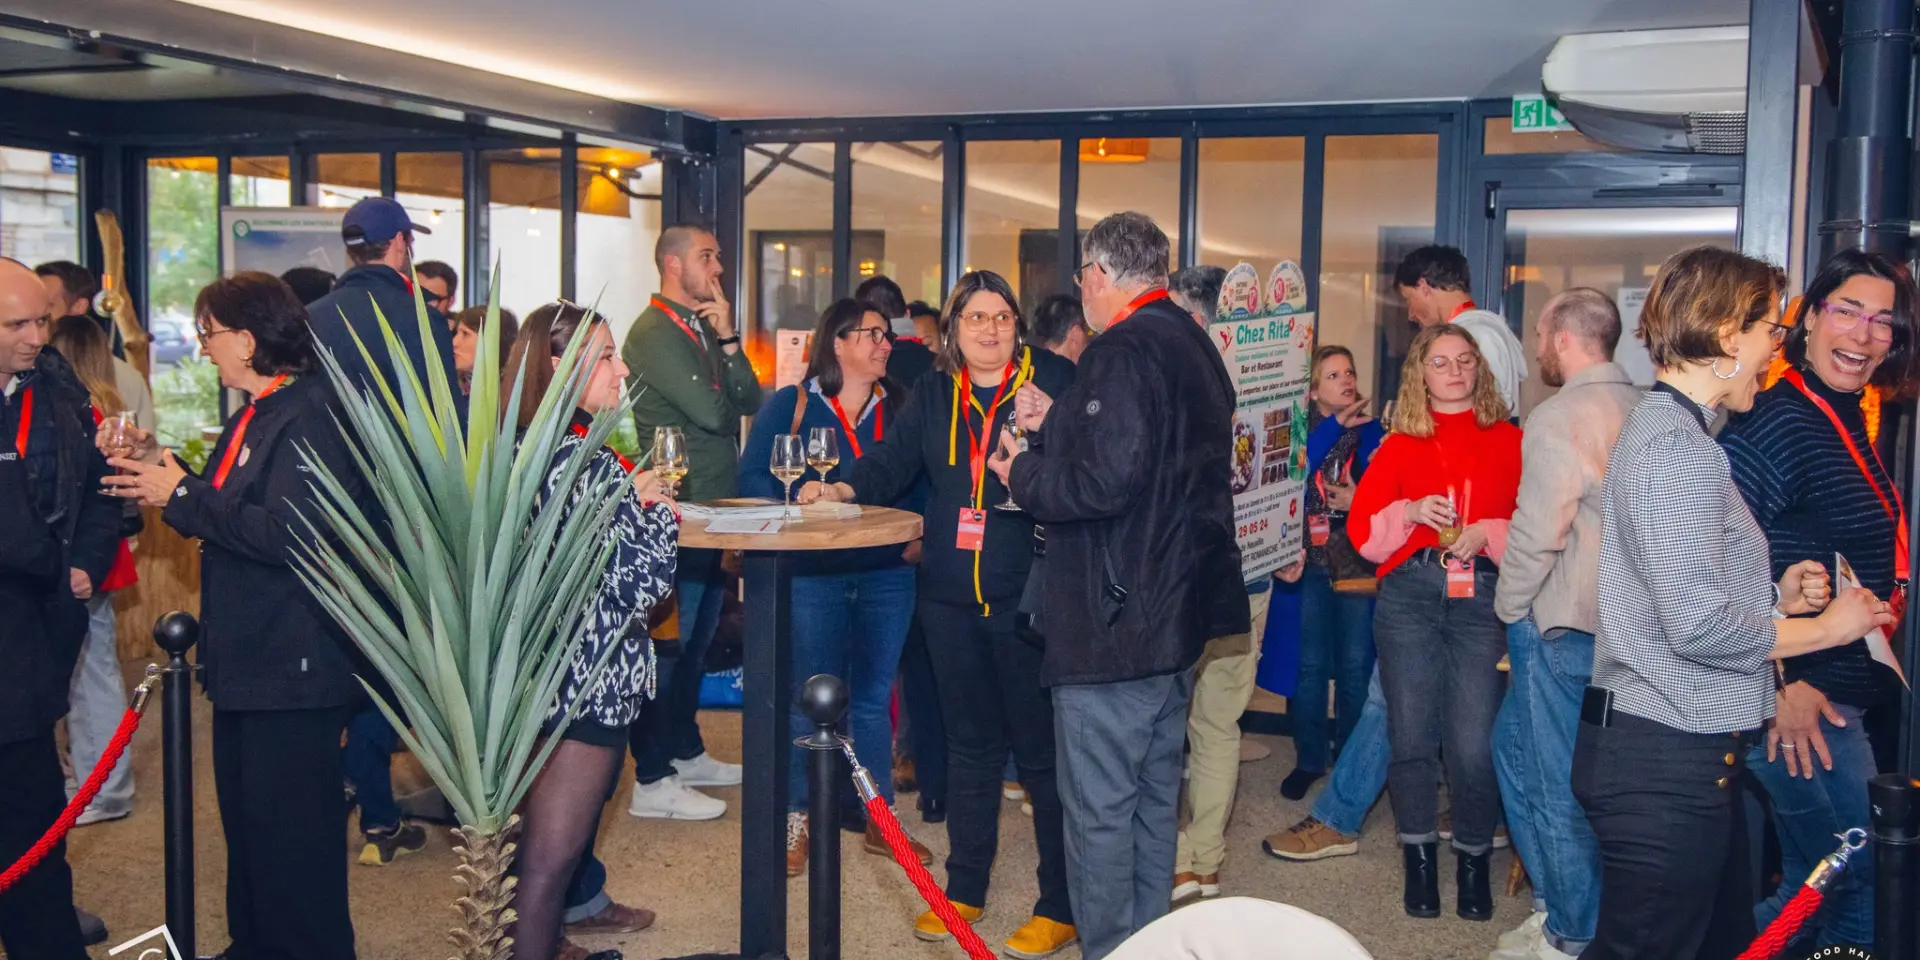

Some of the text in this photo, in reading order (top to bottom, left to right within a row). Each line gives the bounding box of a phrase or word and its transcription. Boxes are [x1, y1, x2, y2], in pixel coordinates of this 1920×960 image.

[1236, 320, 1290, 345] Chez Rita
[1241, 360, 1283, 374] Bar et Restaurant
[1238, 518, 1268, 538] 29 05 24
